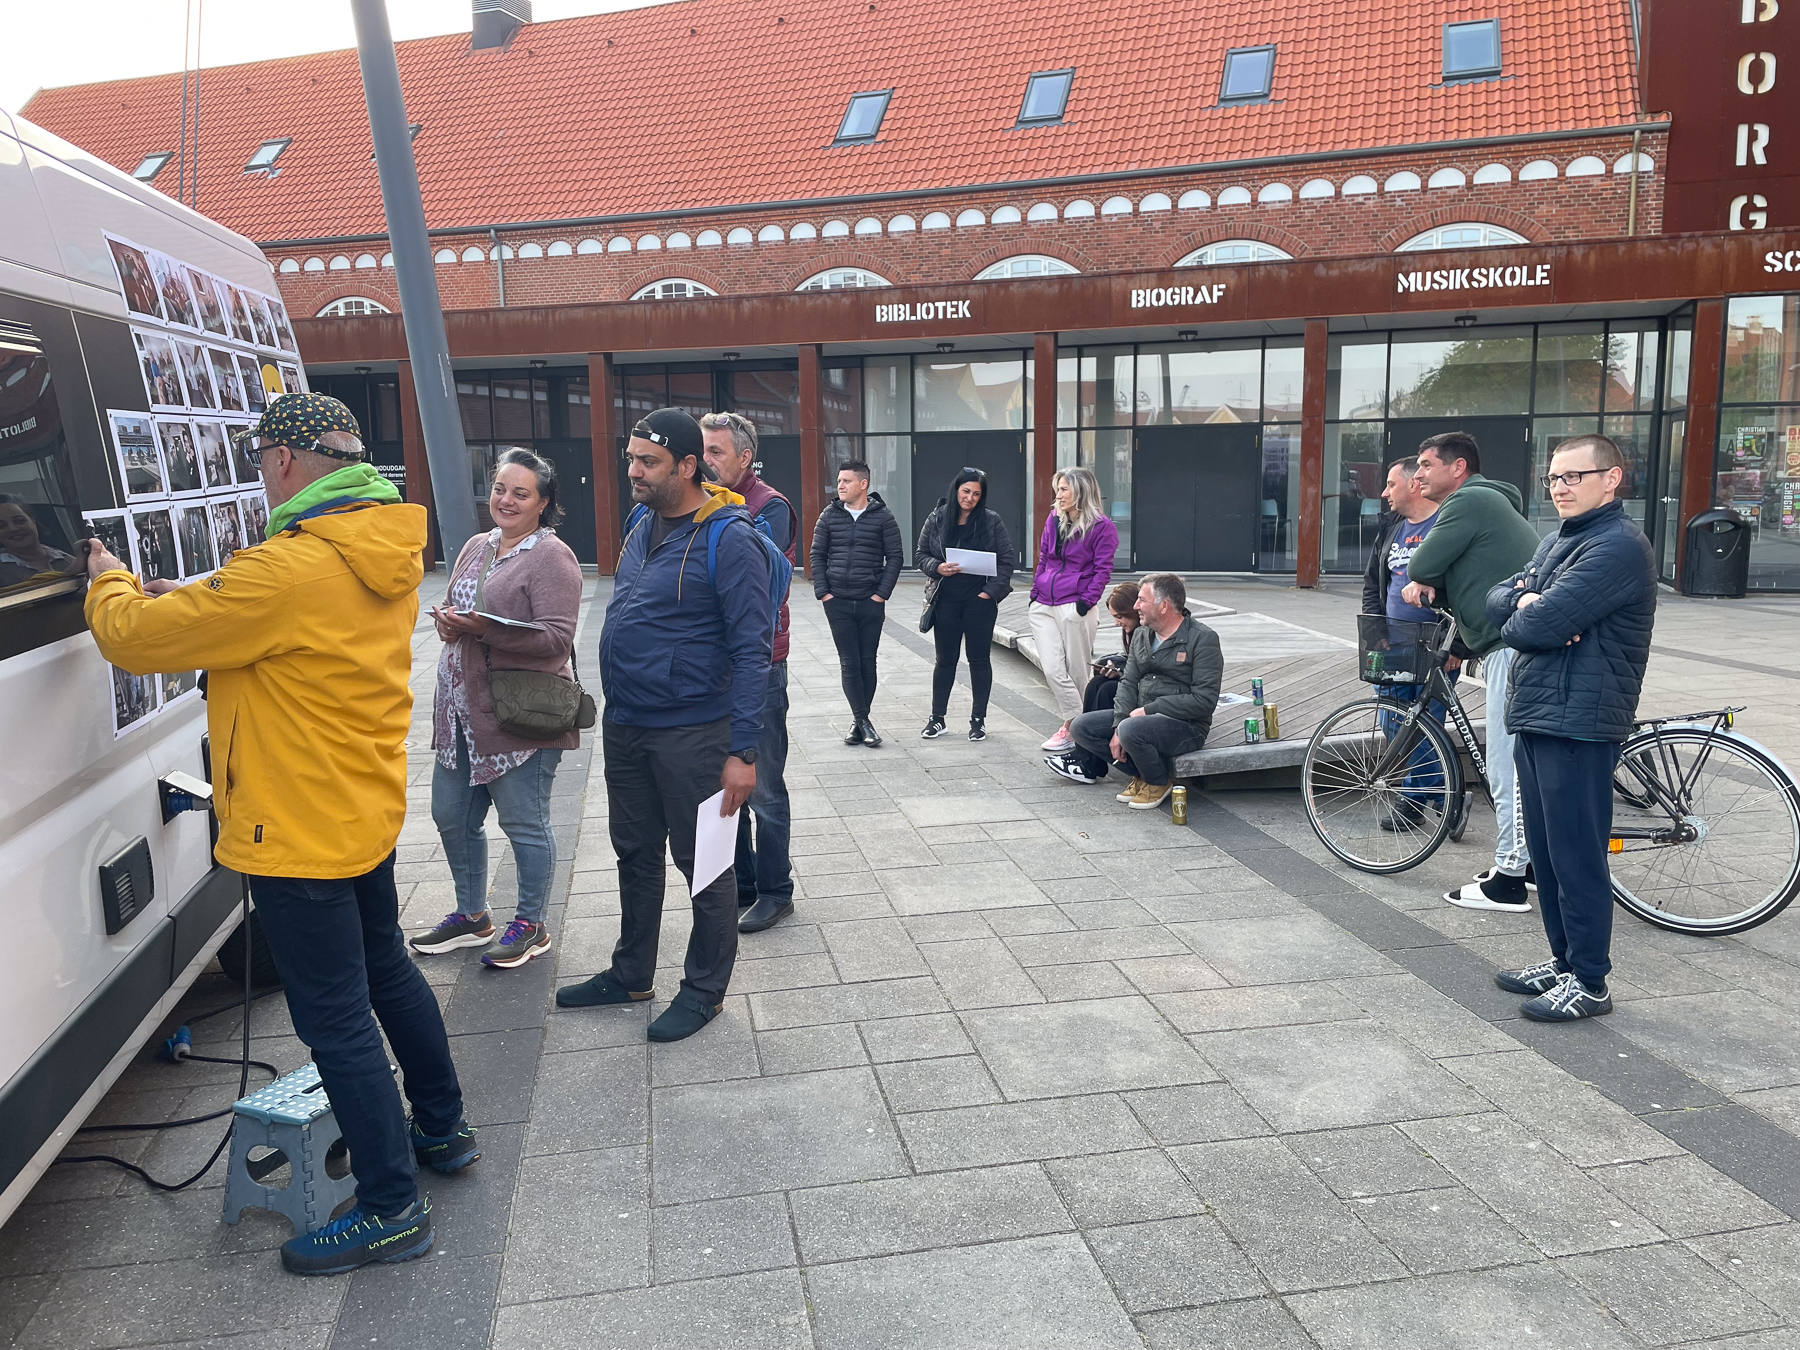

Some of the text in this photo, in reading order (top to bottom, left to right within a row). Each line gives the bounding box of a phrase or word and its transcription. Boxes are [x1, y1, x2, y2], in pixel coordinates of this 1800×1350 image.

[1397, 264, 1552, 293] MUSIKSKOLE
[1131, 284, 1226, 309] BIOGRAF
[875, 300, 971, 323] BIBLIOTEK
[380, 1226, 419, 1246] SPORTIVA
